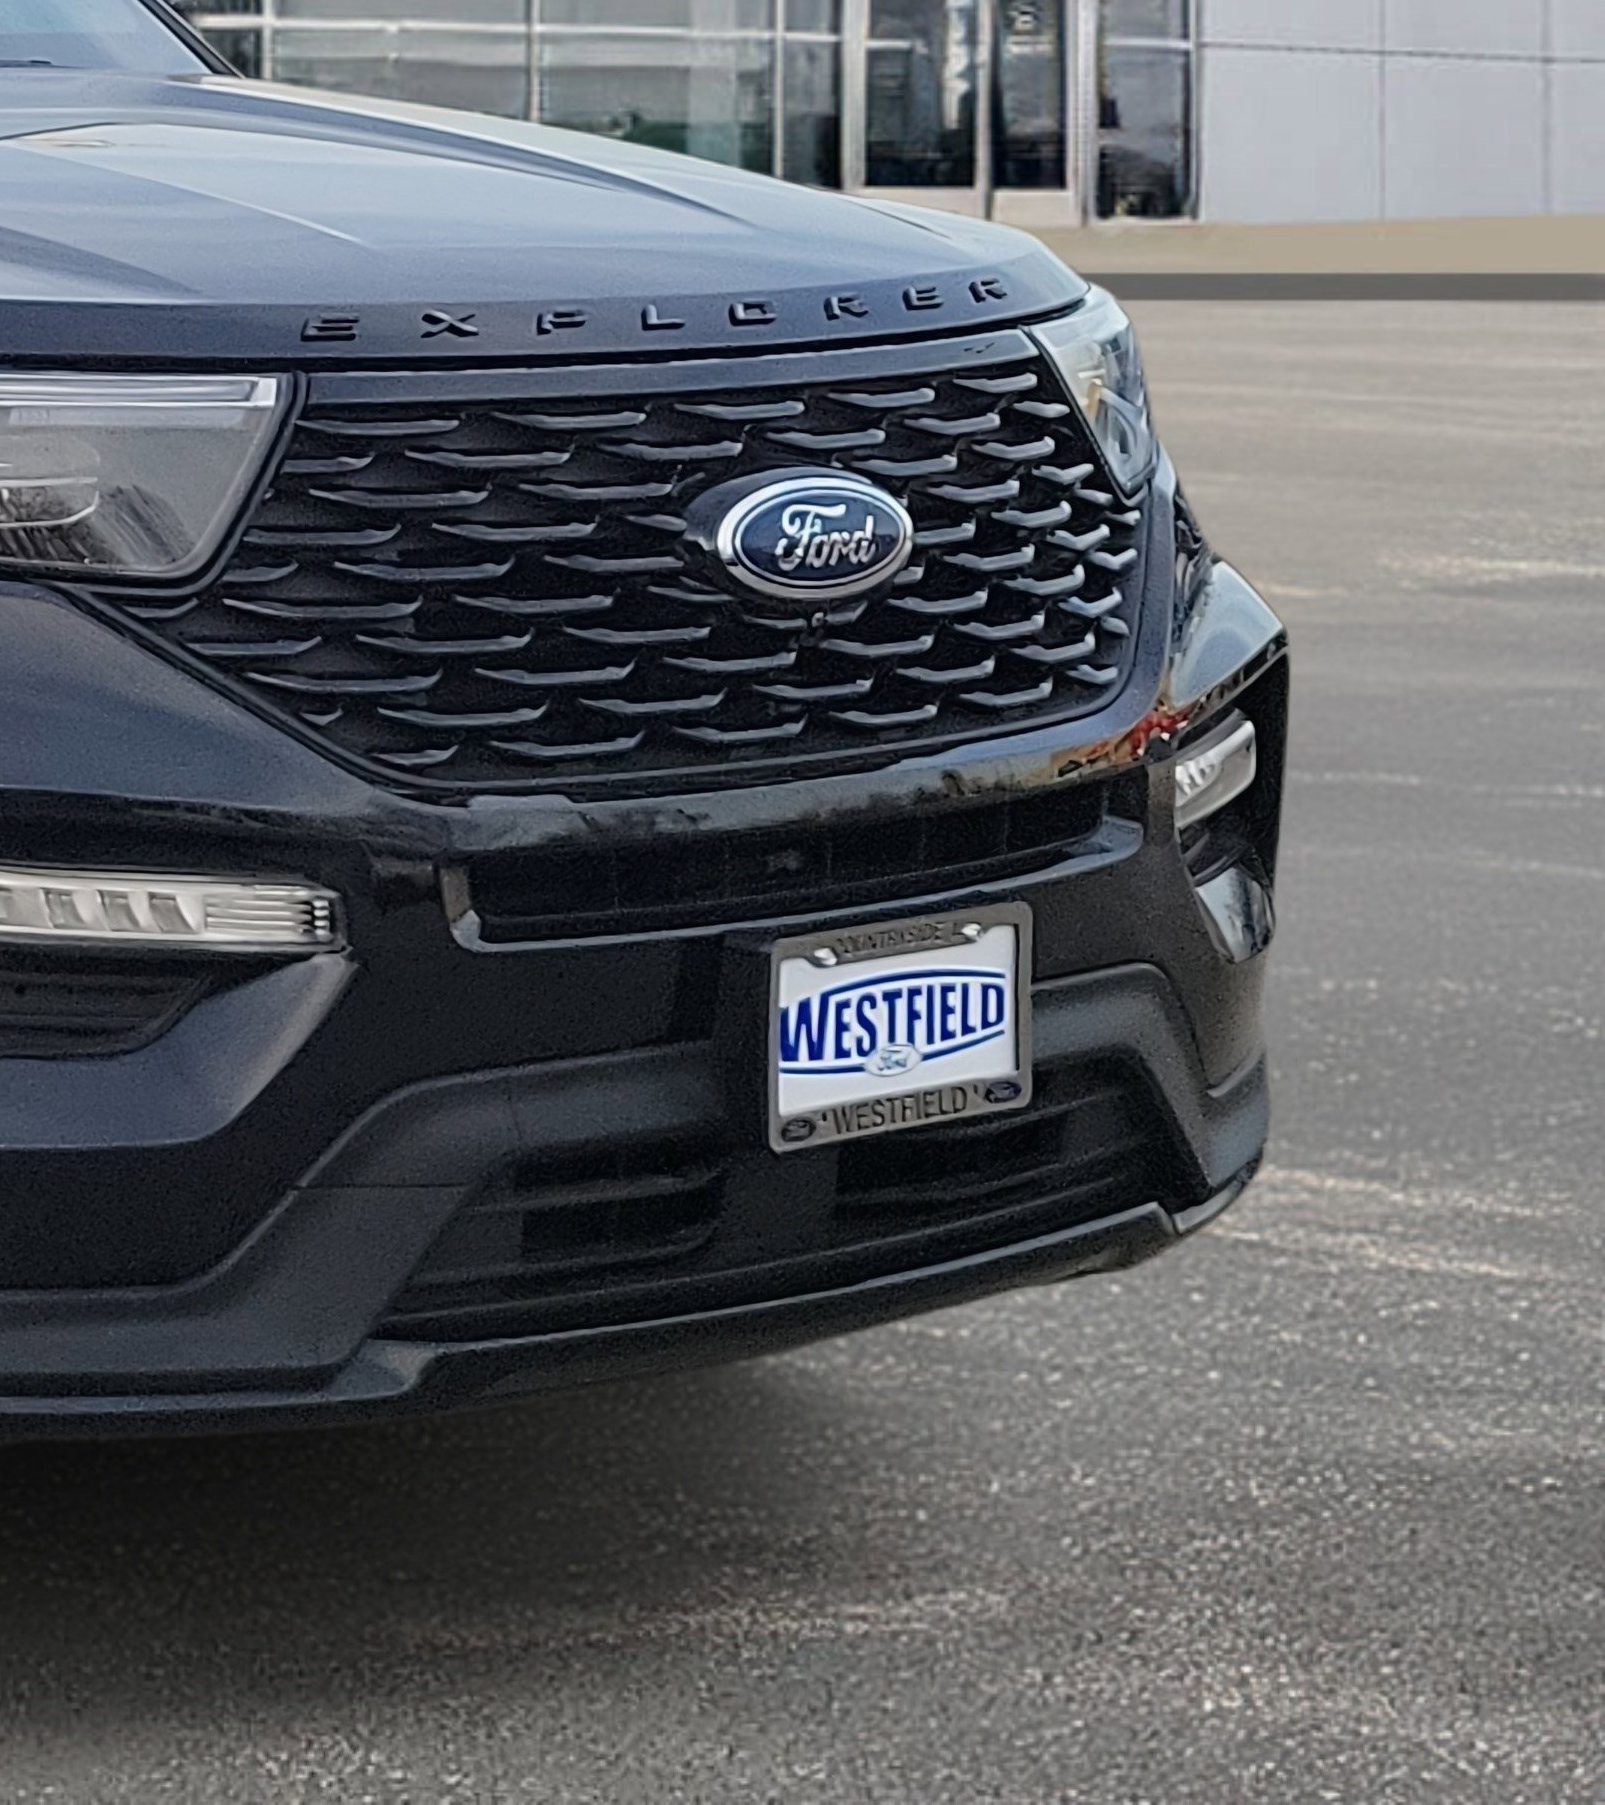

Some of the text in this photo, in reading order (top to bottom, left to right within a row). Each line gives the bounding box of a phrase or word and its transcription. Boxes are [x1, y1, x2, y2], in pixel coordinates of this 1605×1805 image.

[300, 276, 1008, 342] EXPLORER
[774, 502, 877, 572] Ford
[780, 982, 1005, 1062] WESTFIELD
[828, 1086, 968, 1135] WESTFIELD
